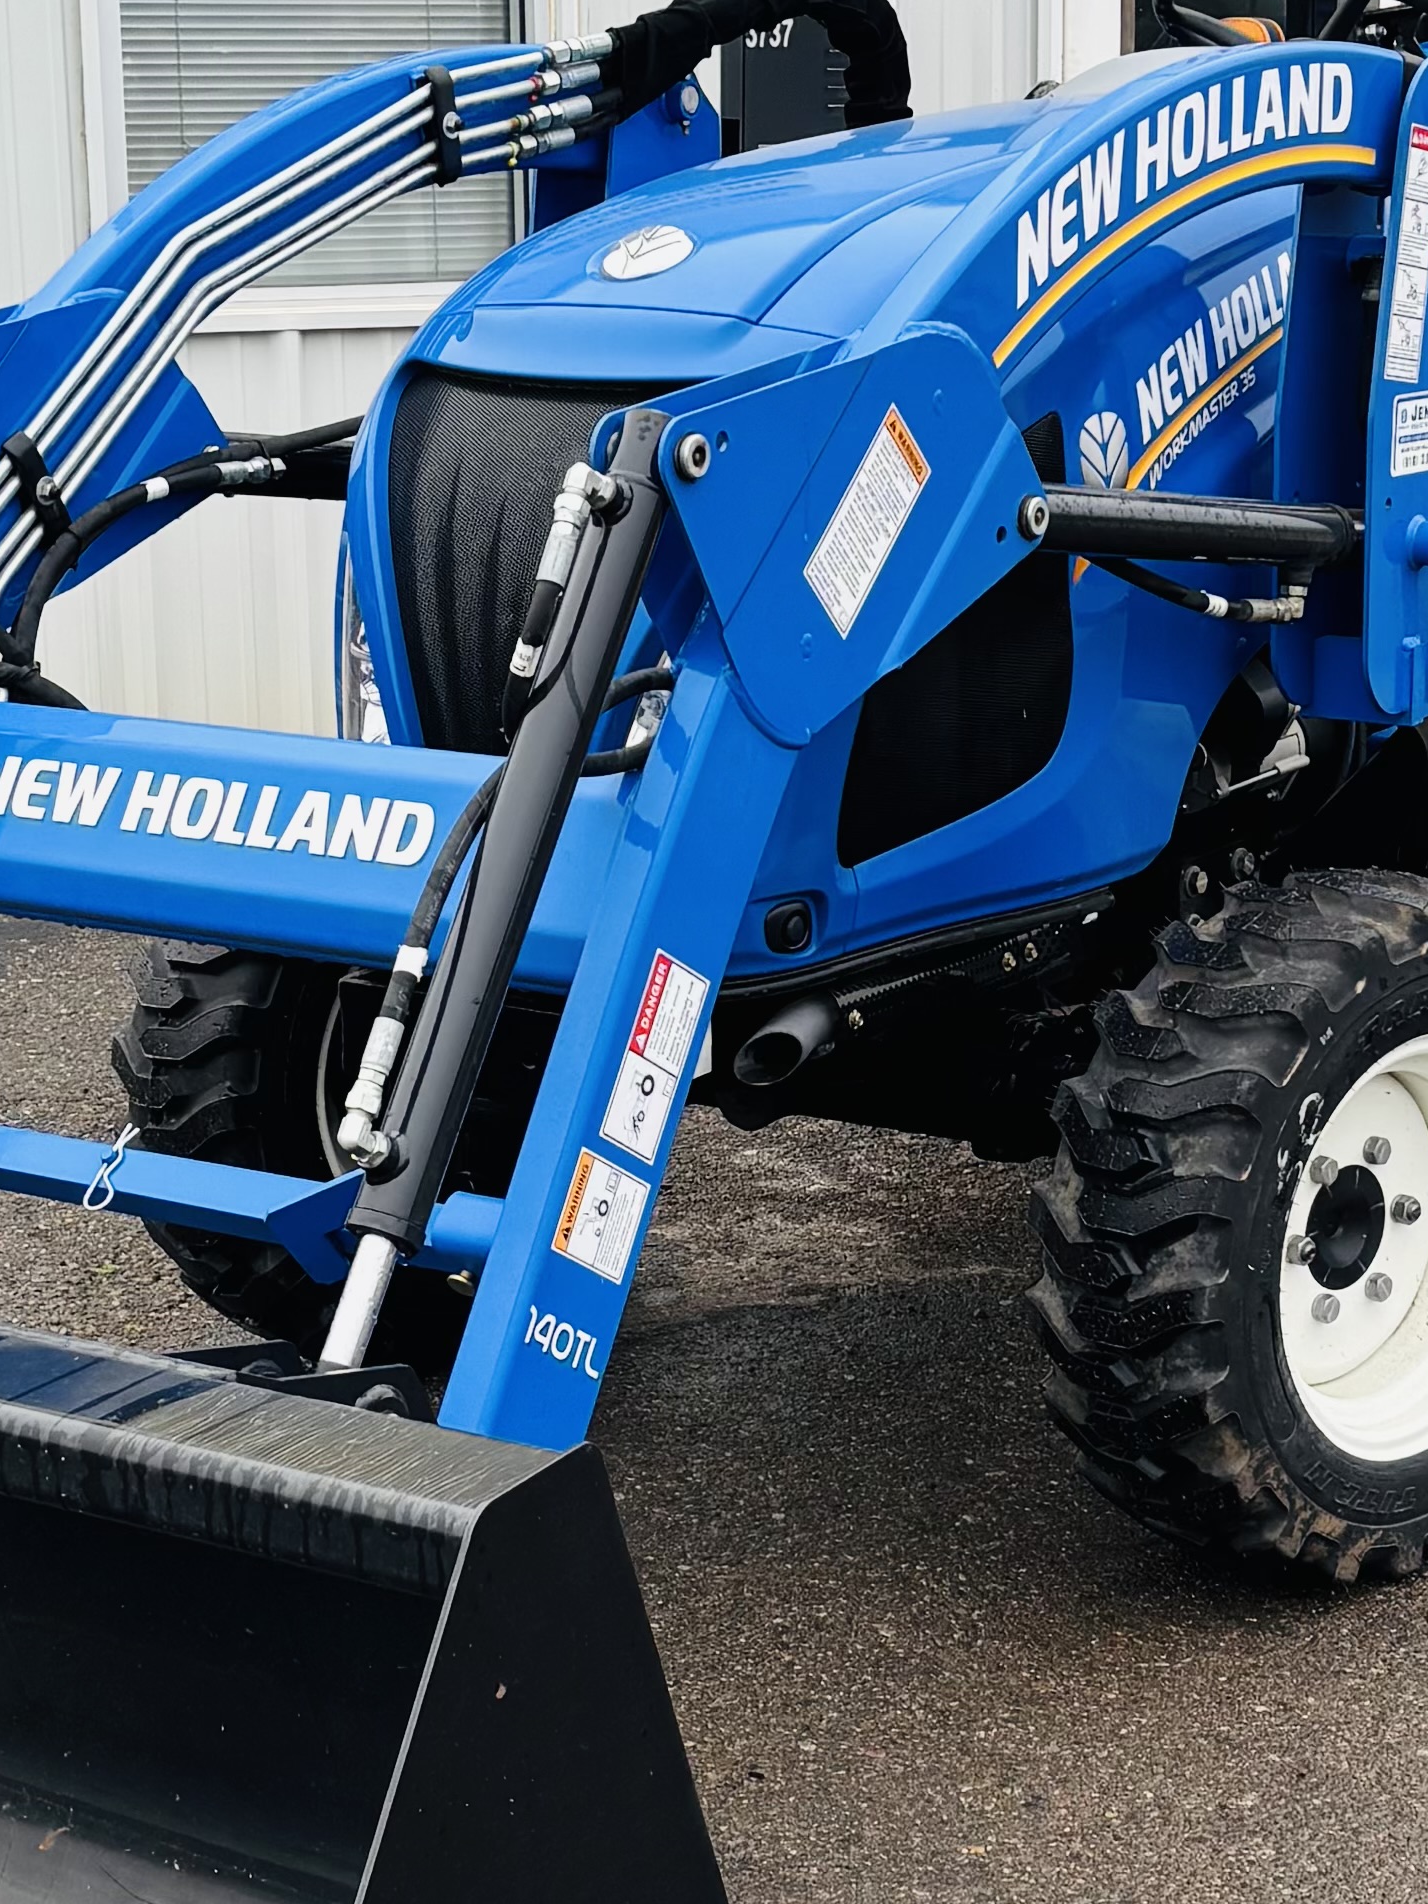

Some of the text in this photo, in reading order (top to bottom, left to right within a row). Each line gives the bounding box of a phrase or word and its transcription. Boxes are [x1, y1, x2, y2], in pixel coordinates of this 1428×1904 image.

[1016, 62, 1353, 310] NEW HOLLAND
[1135, 317, 1209, 445] NEW
[1147, 365, 1257, 491] WORKMASTER 35
[120, 770, 435, 867] HOLLAND
[640, 962, 668, 1029] DANGER
[524, 1304, 600, 1380] 140TL
